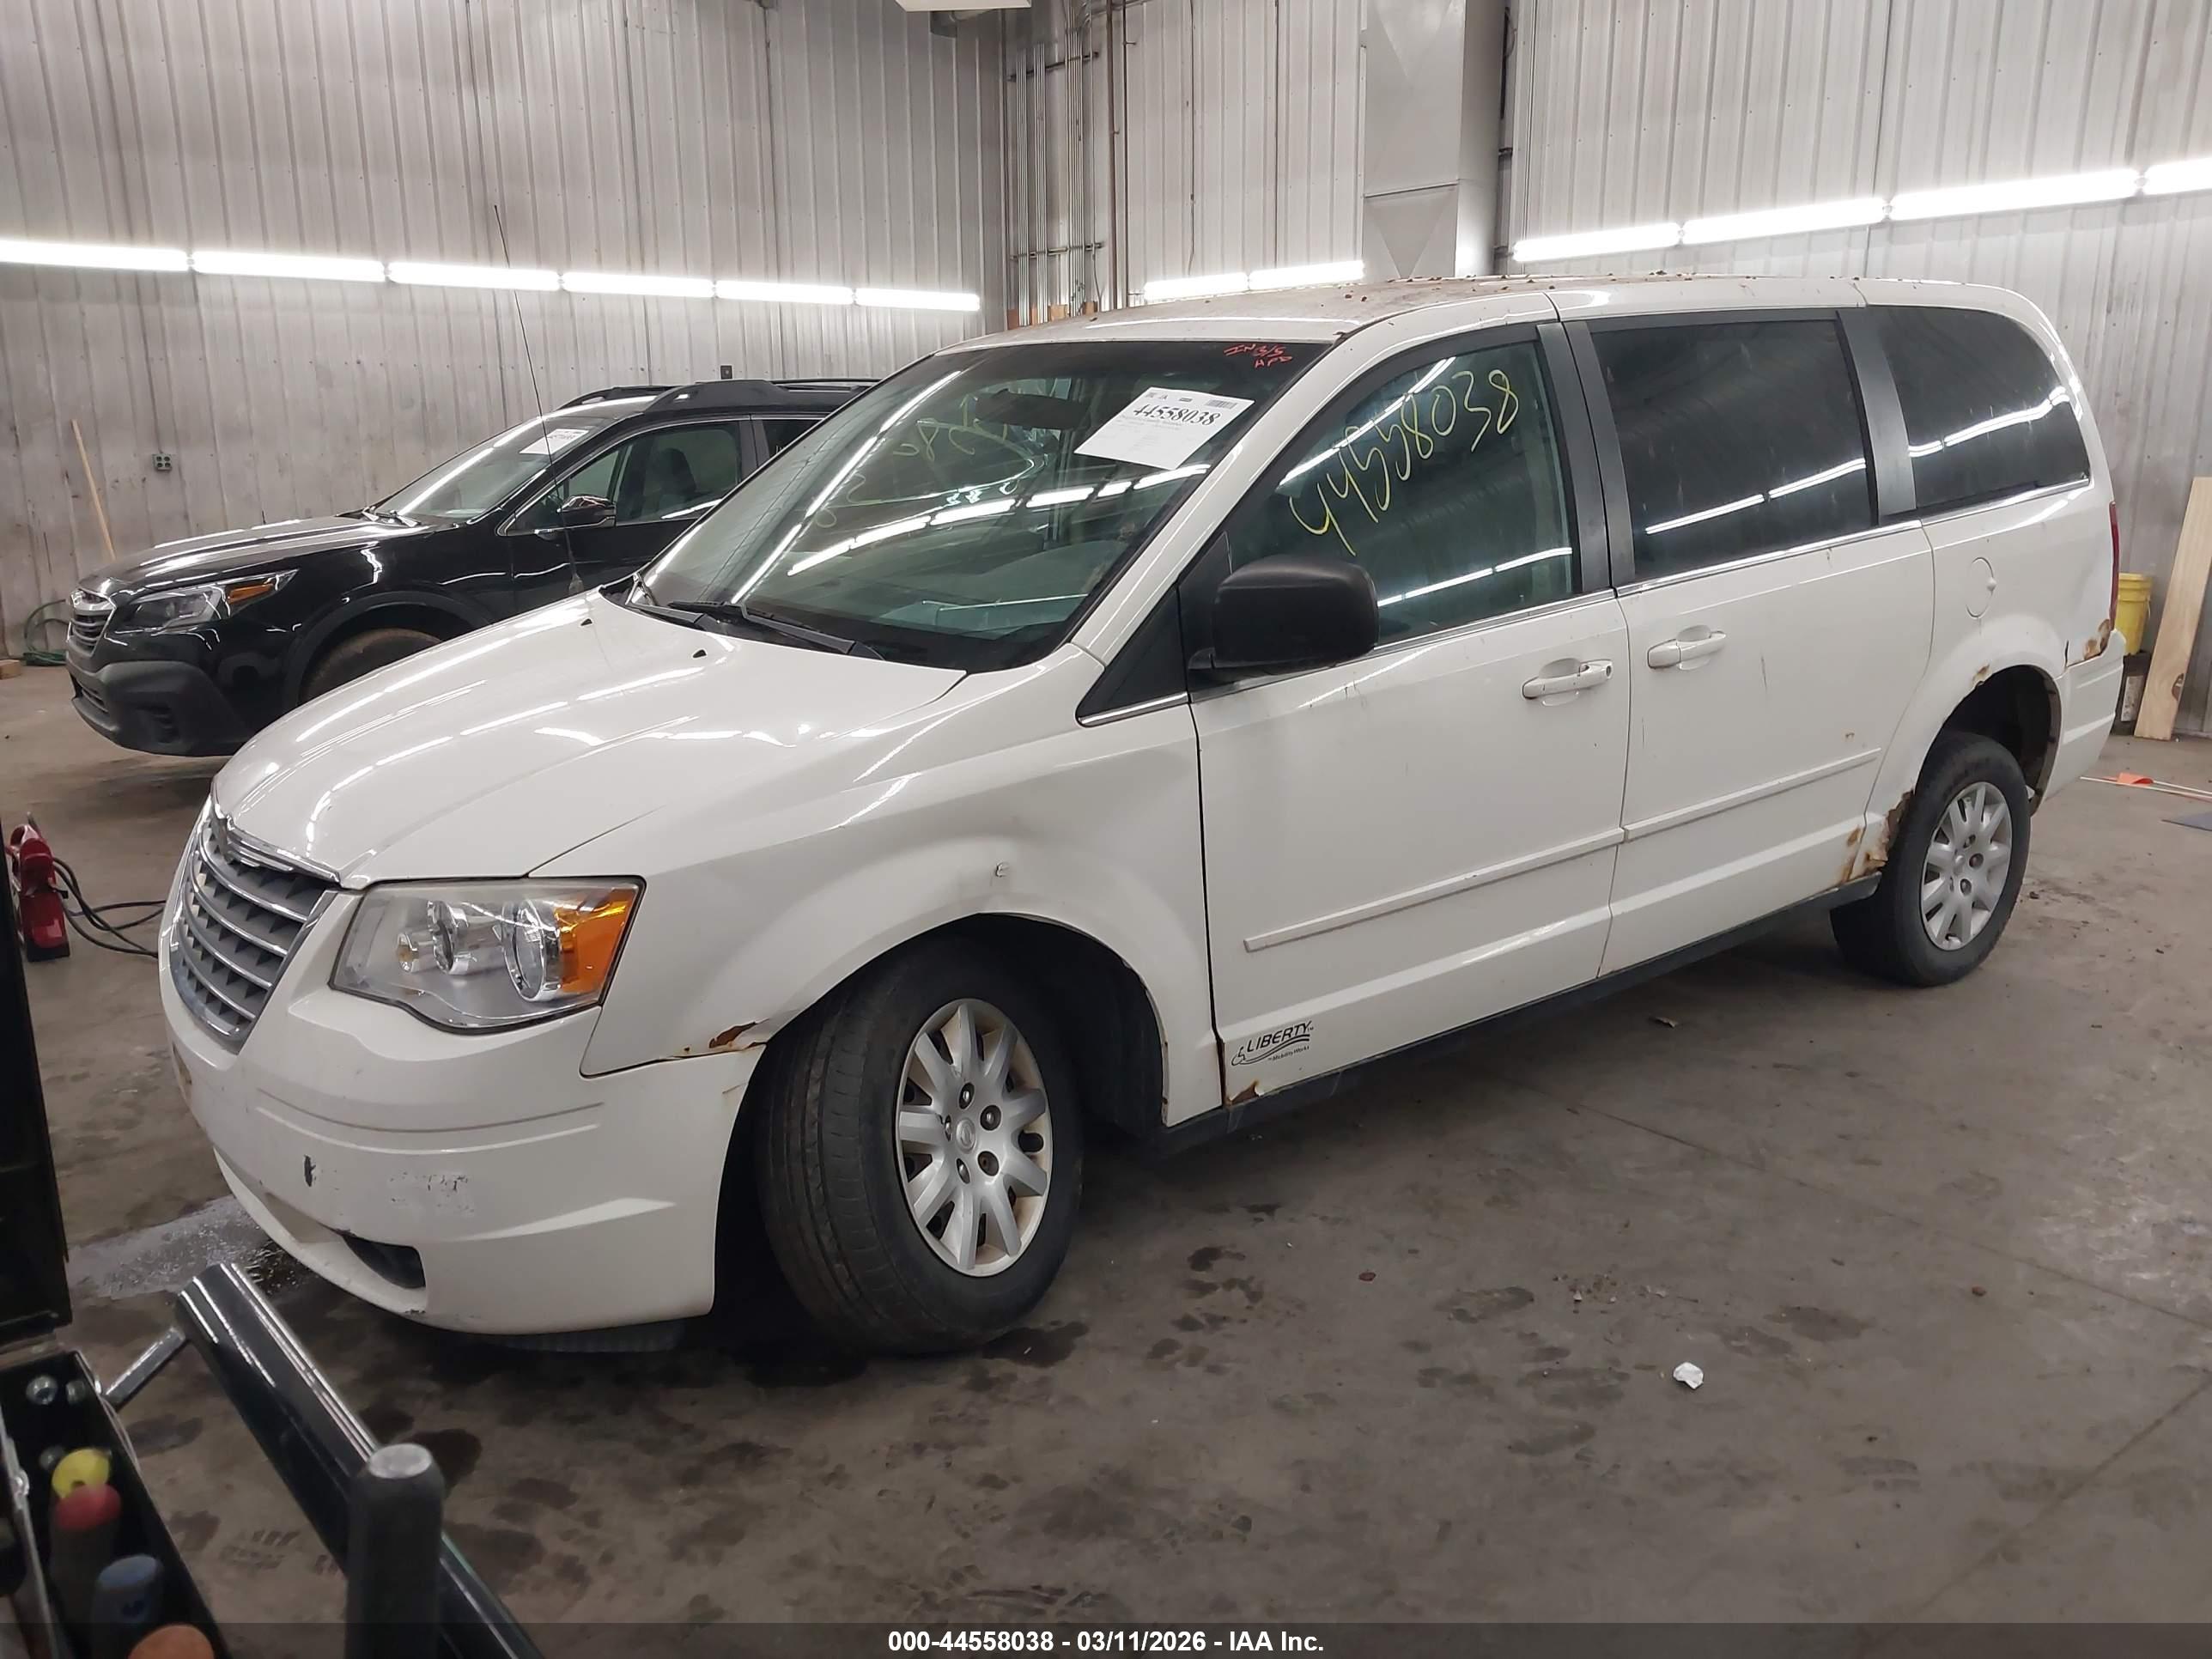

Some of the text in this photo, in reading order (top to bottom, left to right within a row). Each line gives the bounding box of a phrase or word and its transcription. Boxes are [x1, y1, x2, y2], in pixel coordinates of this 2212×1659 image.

[1133, 404, 1220, 426] 44558038
[1289, 369, 1519, 556] 44558038
[1247, 1020, 1312, 1052] LIBERTY
